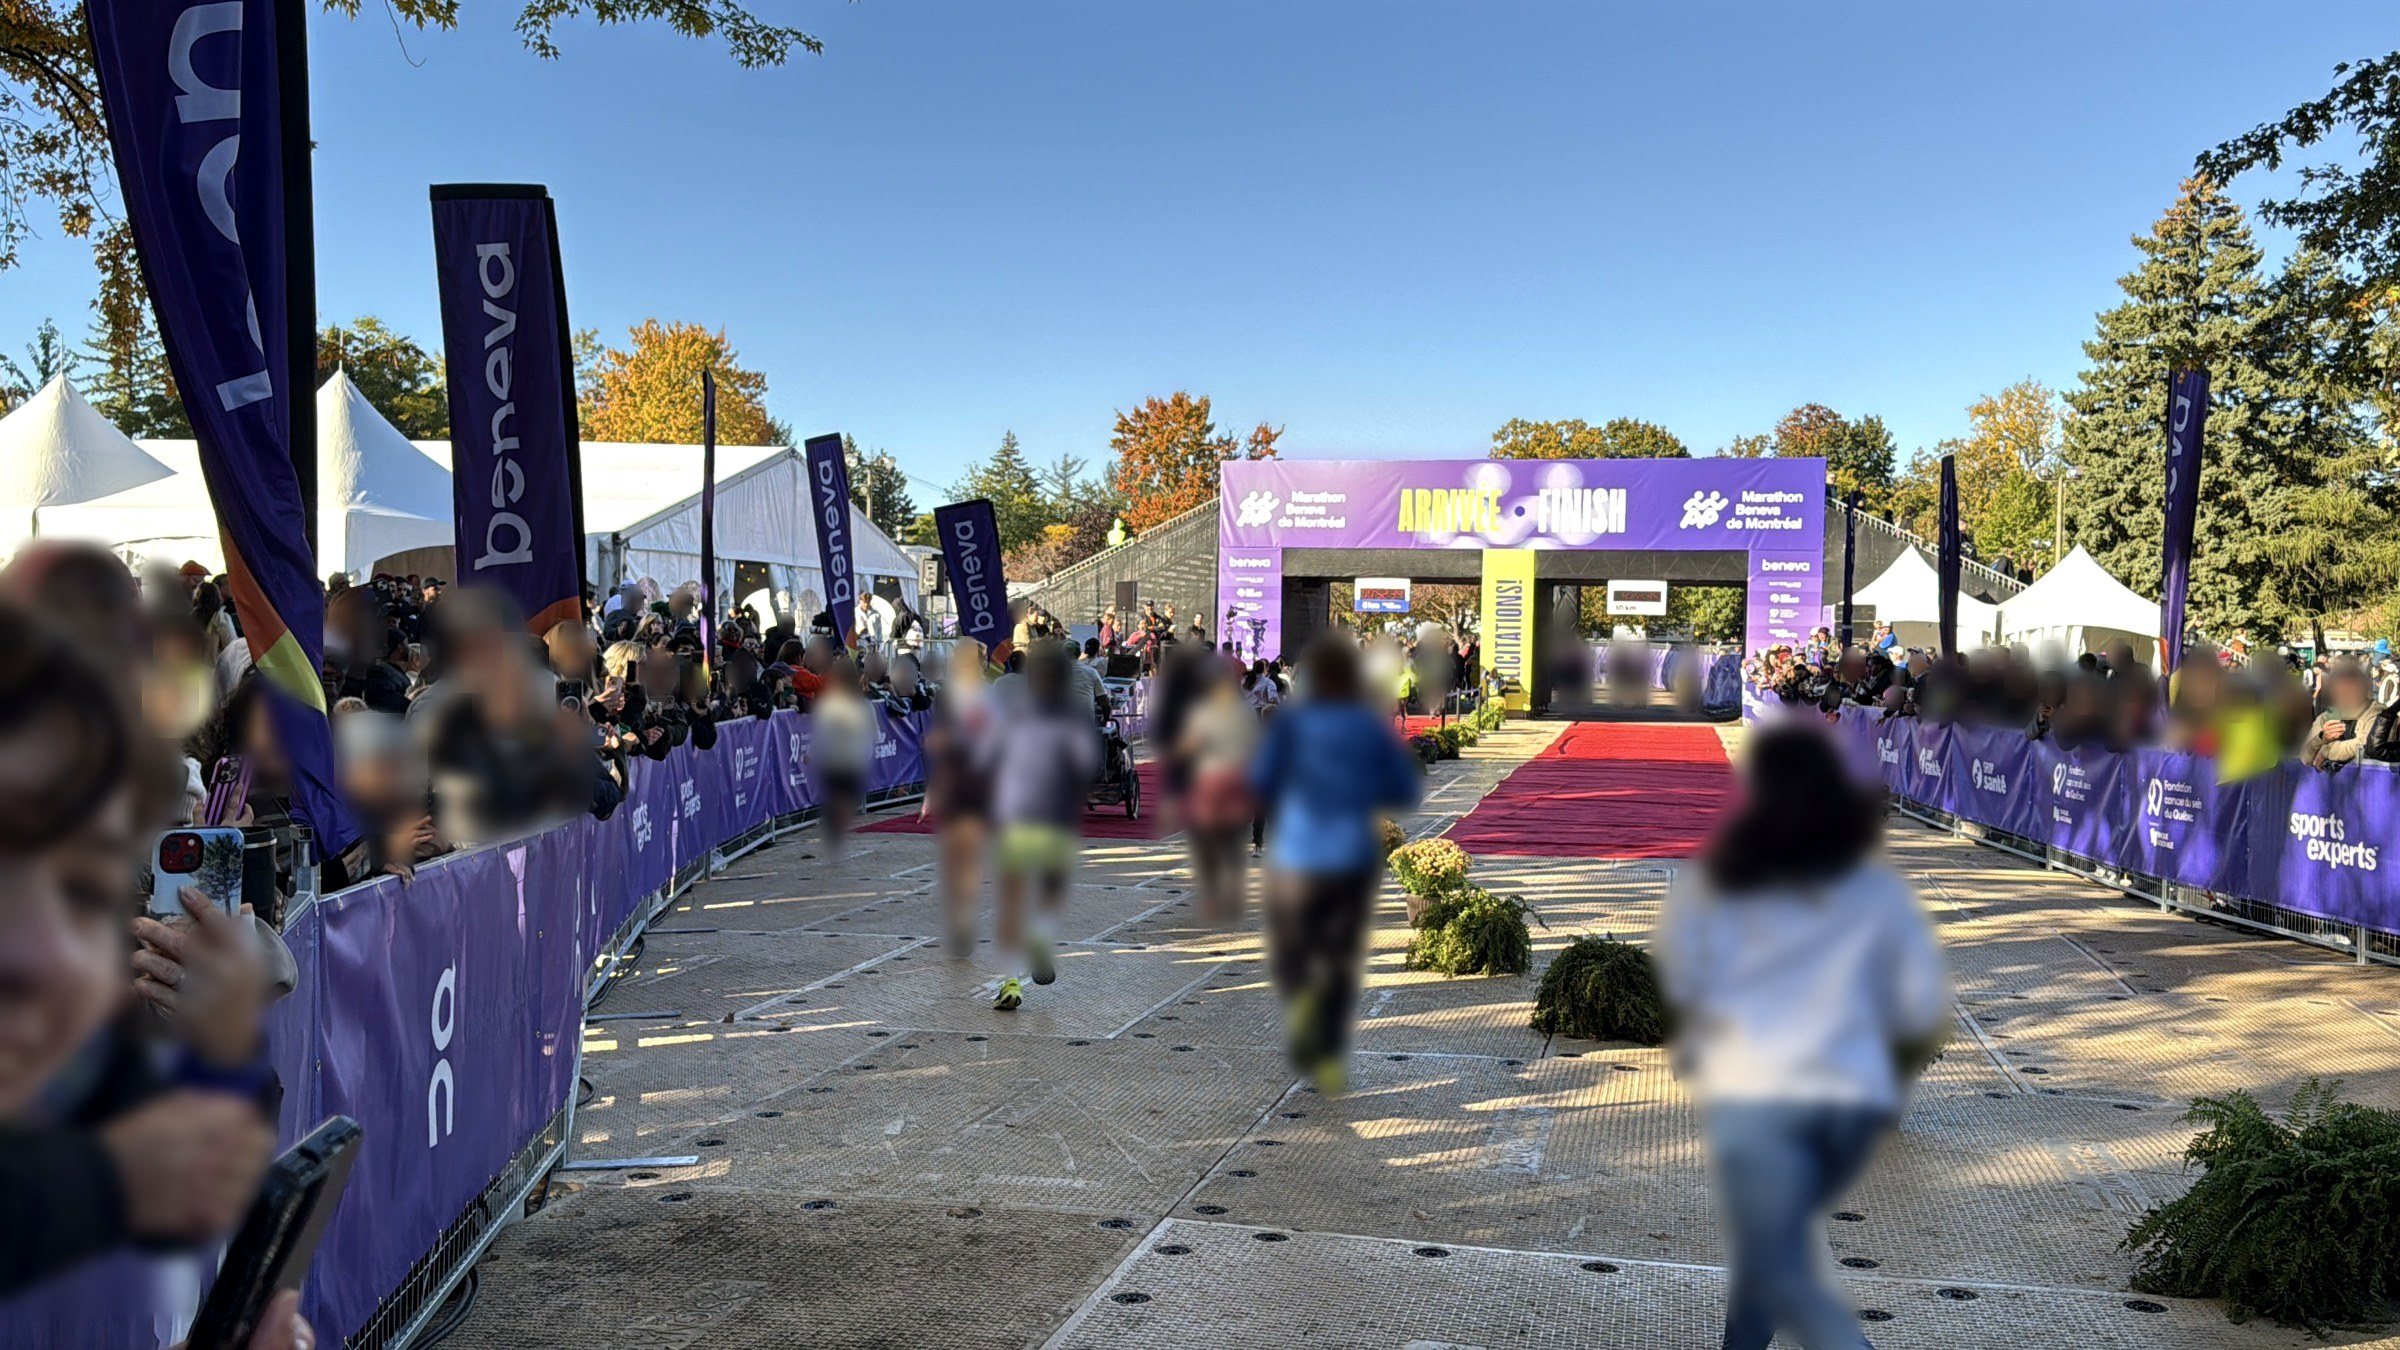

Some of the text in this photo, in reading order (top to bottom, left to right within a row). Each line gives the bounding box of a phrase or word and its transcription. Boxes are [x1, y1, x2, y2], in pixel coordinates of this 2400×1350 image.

[474, 242, 533, 571] beneva
[1291, 491, 1346, 503] Marathon
[1742, 491, 1804, 503] Marathon
[1285, 503, 1326, 515] Beneva
[1398, 482, 1502, 532] ARRIVÉE
[1538, 488, 1627, 533] FINISH
[1735, 504, 1781, 516] Beneva
[1278, 516, 1346, 528] de Montréal
[1726, 517, 1803, 530] de Montréal
[818, 459, 851, 606] beneva
[1228, 555, 1271, 568] beneva
[1762, 559, 1810, 572] beneva
[954, 519, 995, 634] beneva
[1983, 774, 2007, 795] santé
[2164, 779, 2193, 793] Fondation
[2164, 796, 2203, 810] cancer du sein
[2164, 808, 2194, 822] du Québec
[2290, 812, 2345, 841] sports
[2307, 838, 2377, 871] experts
